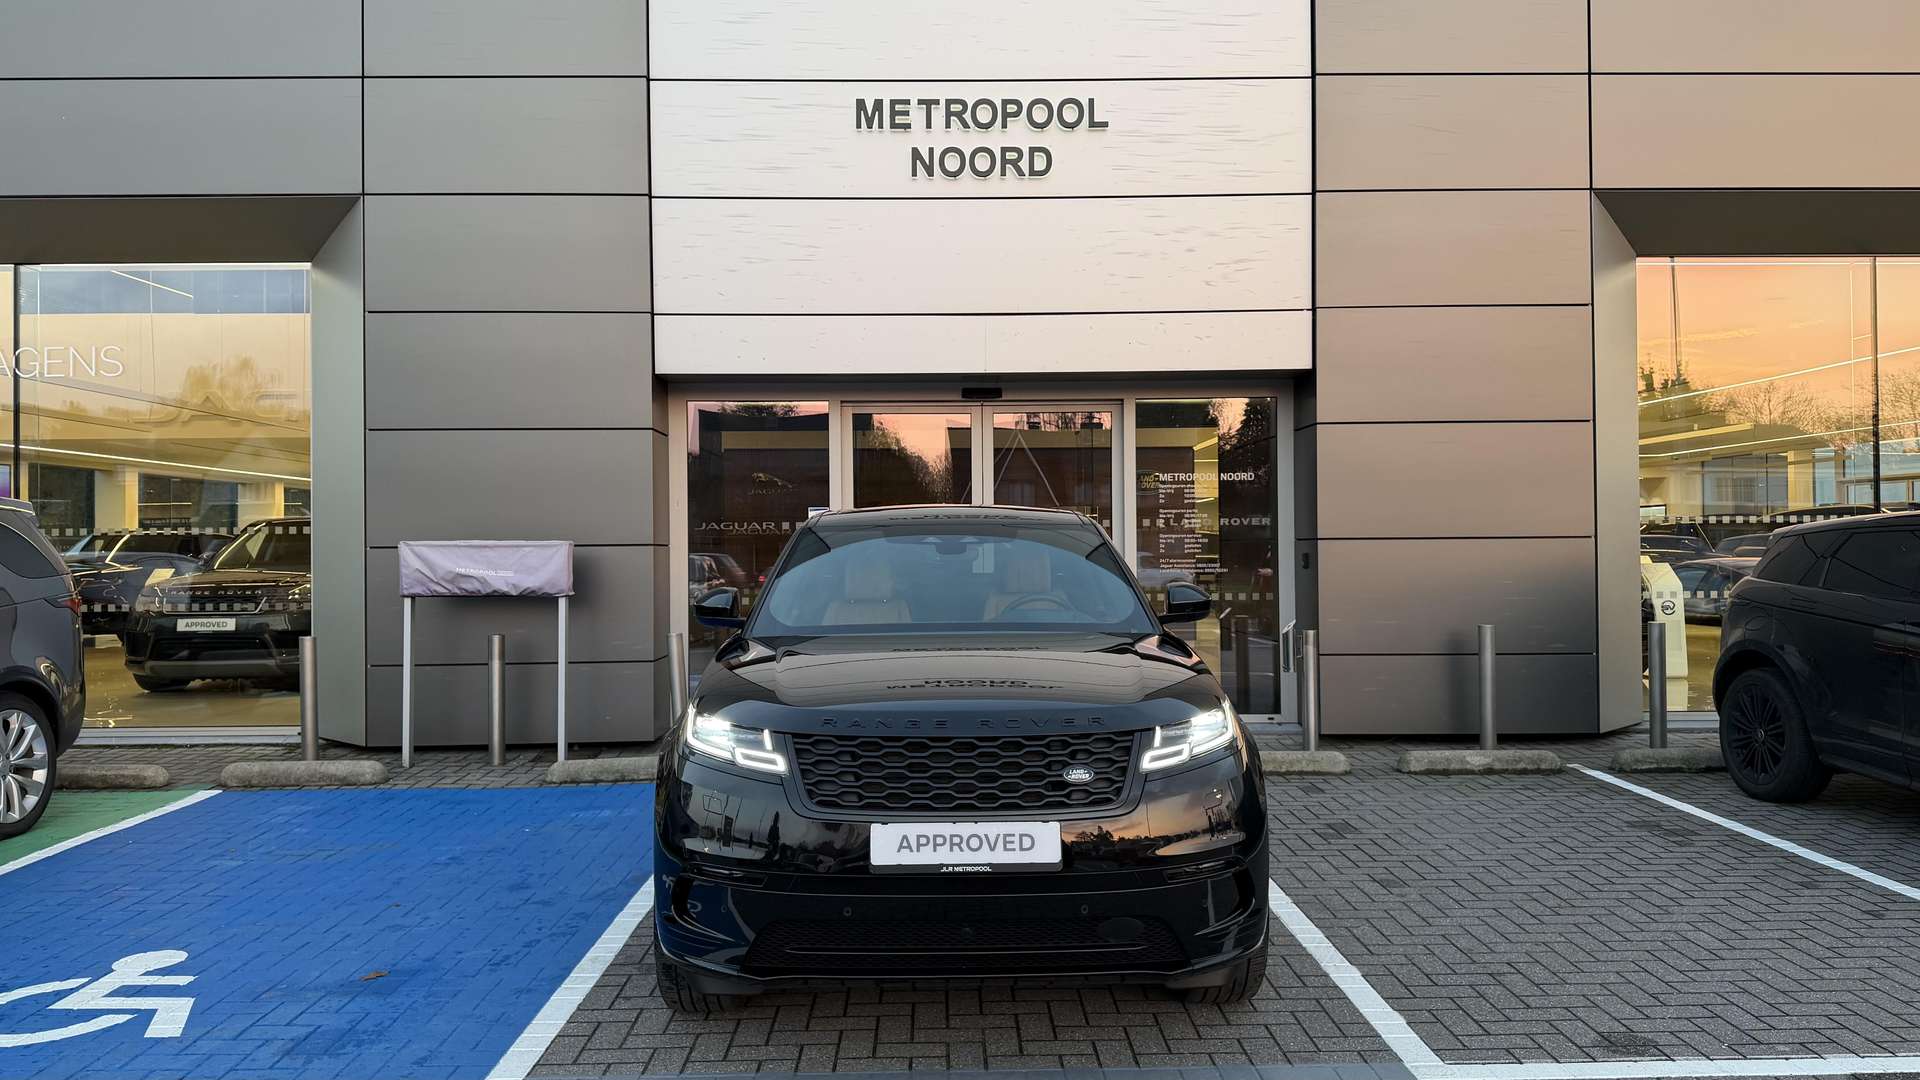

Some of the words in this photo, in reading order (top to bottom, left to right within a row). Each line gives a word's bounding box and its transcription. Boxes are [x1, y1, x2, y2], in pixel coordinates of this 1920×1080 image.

[855, 97, 1109, 130] METROPOOL
[911, 146, 1053, 178] NOORD
[1159, 472, 1218, 481] METROPOOL
[1220, 472, 1255, 481] NOORD
[694, 521, 775, 530] JAGUAR
[1220, 517, 1271, 526] ROVER
[184, 621, 228, 629] APPROVED
[821, 717, 949, 729] RANGE
[975, 716, 1105, 729] ROVER
[896, 833, 1036, 853] APPROVED
